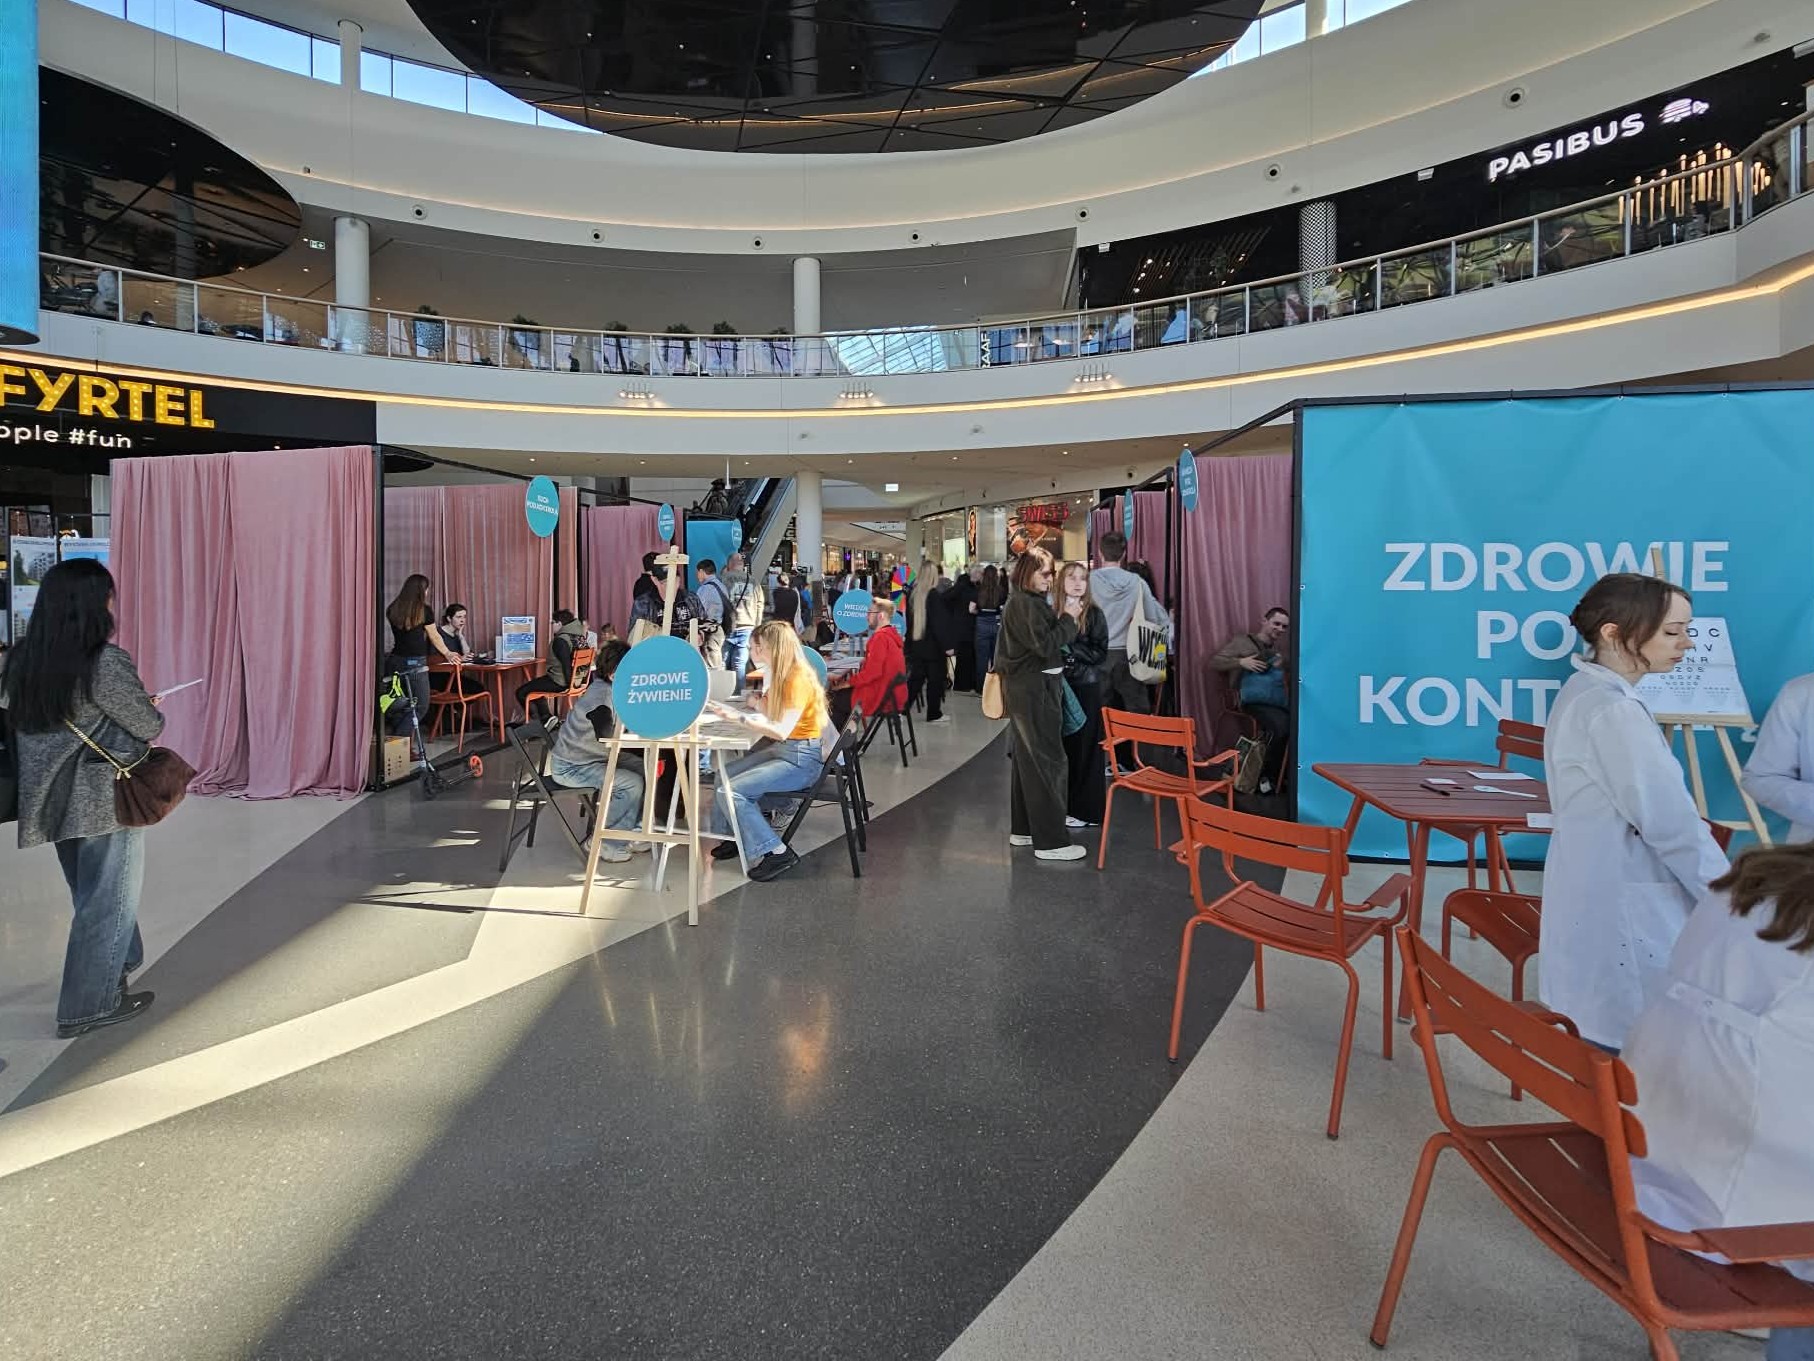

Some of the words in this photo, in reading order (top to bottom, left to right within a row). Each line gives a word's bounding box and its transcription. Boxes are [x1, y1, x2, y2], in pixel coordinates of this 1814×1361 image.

[1488, 112, 1646, 183] PASIBUS
[0, 364, 215, 429] FYRTEL
[69, 427, 132, 449] #fun
[1383, 540, 1730, 592] ZDROWIE
[1477, 610, 1590, 661] PO
[627, 688, 693, 704] ŻYWIENIE
[630, 671, 690, 687] ZDROWE
